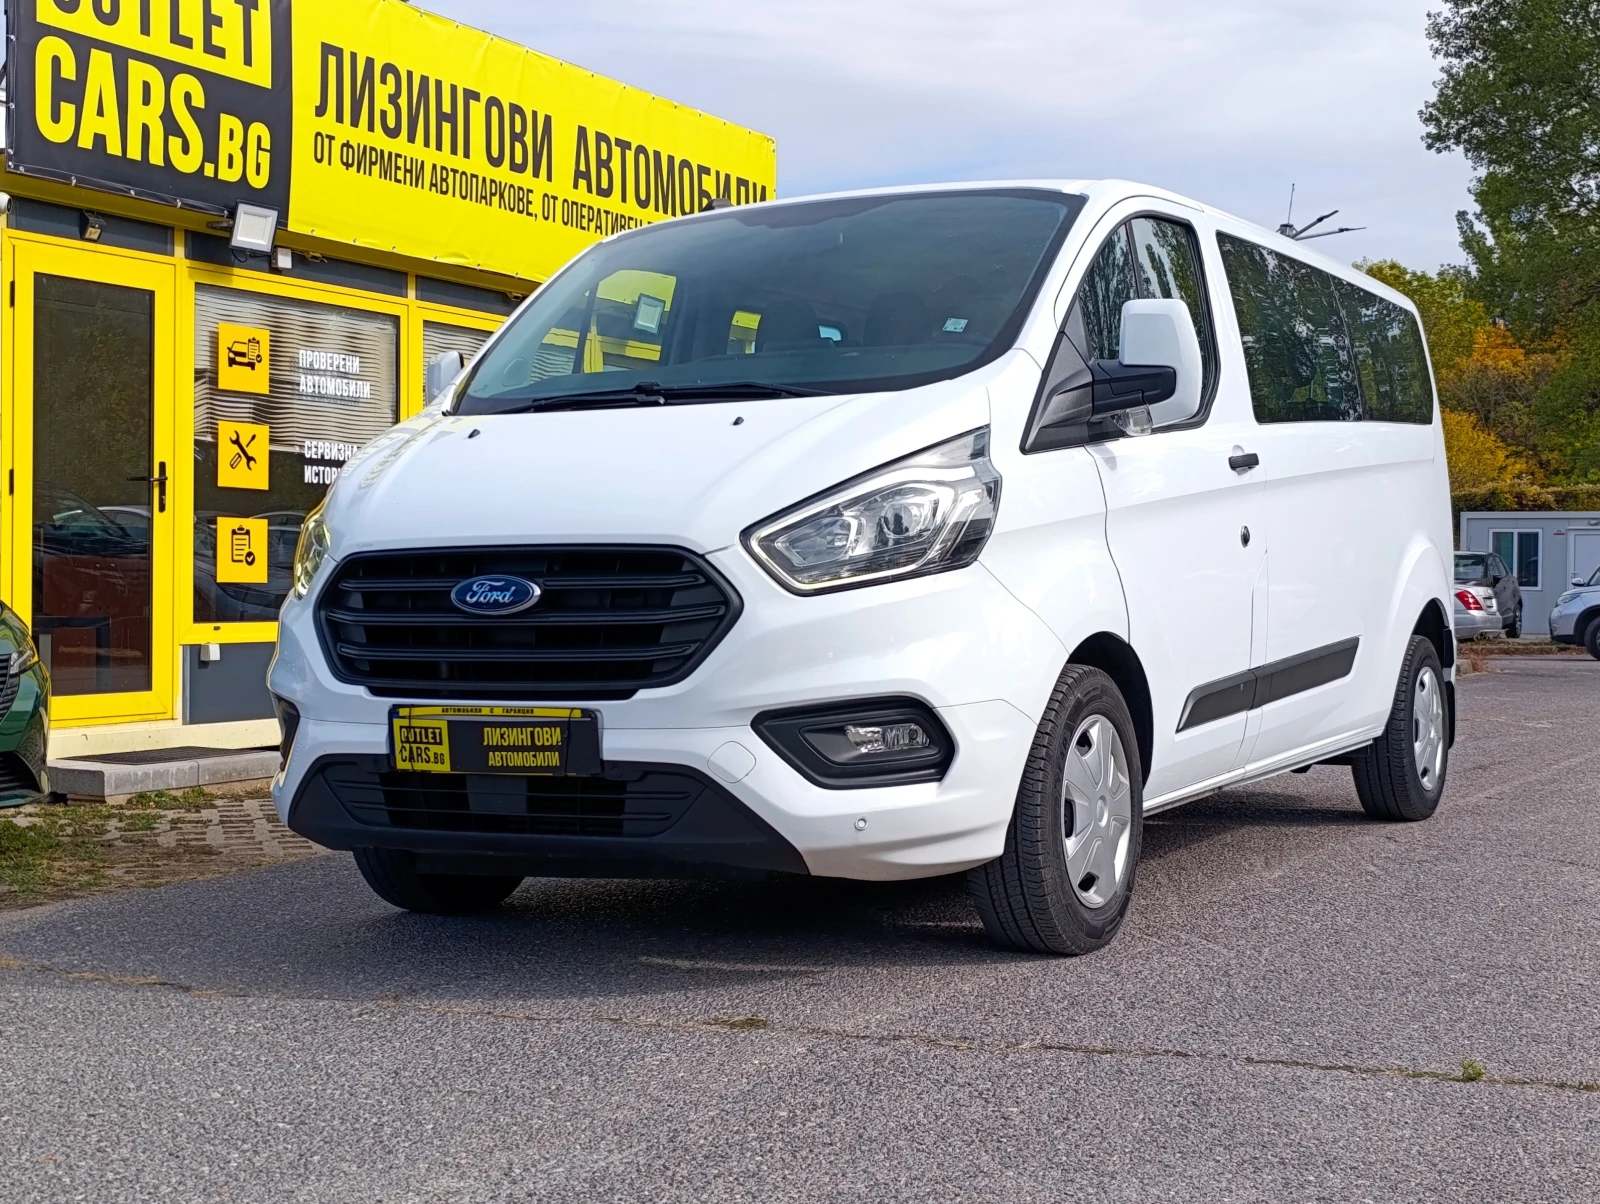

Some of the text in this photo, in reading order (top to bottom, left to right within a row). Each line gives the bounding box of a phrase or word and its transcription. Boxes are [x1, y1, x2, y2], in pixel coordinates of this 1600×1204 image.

[53, 0, 259, 67] LET
[35, 36, 271, 189] CARS.BG
[314, 41, 553, 182] ЛИЗИНГОВИ
[313, 131, 336, 166] ОТ
[340, 140, 425, 190] ФИРМЕНИ
[429, 163, 538, 222] АВТОПАРКОВЕ,
[542, 193, 559, 223] ОТ
[299, 350, 360, 374] ПРОВЕРЕНИ
[299, 375, 371, 399] АВТОМОБИЛИ
[304, 465, 341, 484] ИСТОР
[466, 580, 516, 604] Ford
[401, 728, 441, 743] OUTLET
[483, 727, 562, 746] ЛИЗИНГОВИ
[400, 745, 445, 765] CARS.BG
[488, 751, 560, 767] АВТОМОБИЛИ
